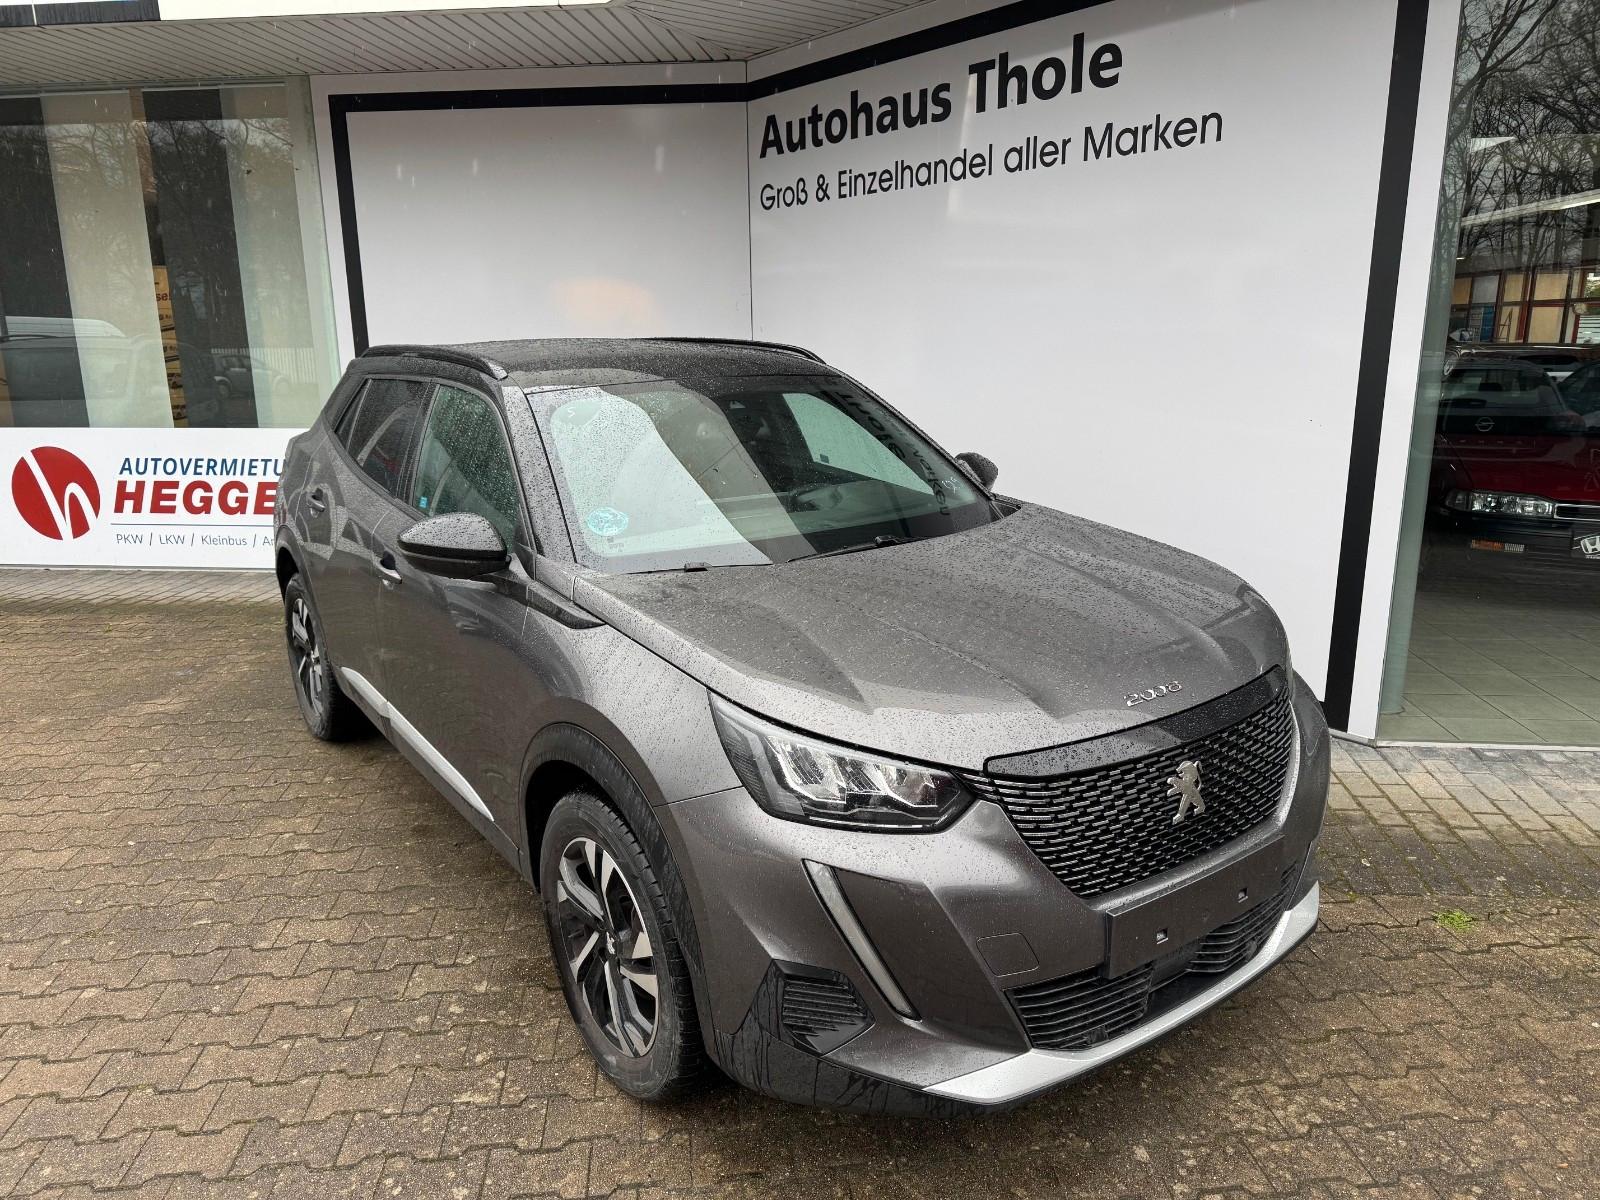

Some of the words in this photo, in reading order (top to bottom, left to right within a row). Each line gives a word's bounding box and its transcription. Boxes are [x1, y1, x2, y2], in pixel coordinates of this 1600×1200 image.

[759, 82, 952, 159] Autohaus
[968, 32, 1123, 114] Thole
[760, 177, 809, 211] Groß
[815, 173, 831, 203] &
[838, 143, 993, 200] Einzelhandel
[1003, 135, 1072, 174] aller
[1083, 112, 1223, 162] Marken
[114, 480, 279, 516] HEGGE
[116, 533, 144, 545] PKW
[159, 534, 186, 546] LKW
[201, 534, 248, 547] Kleinbus
[1123, 681, 1182, 707] 2008
